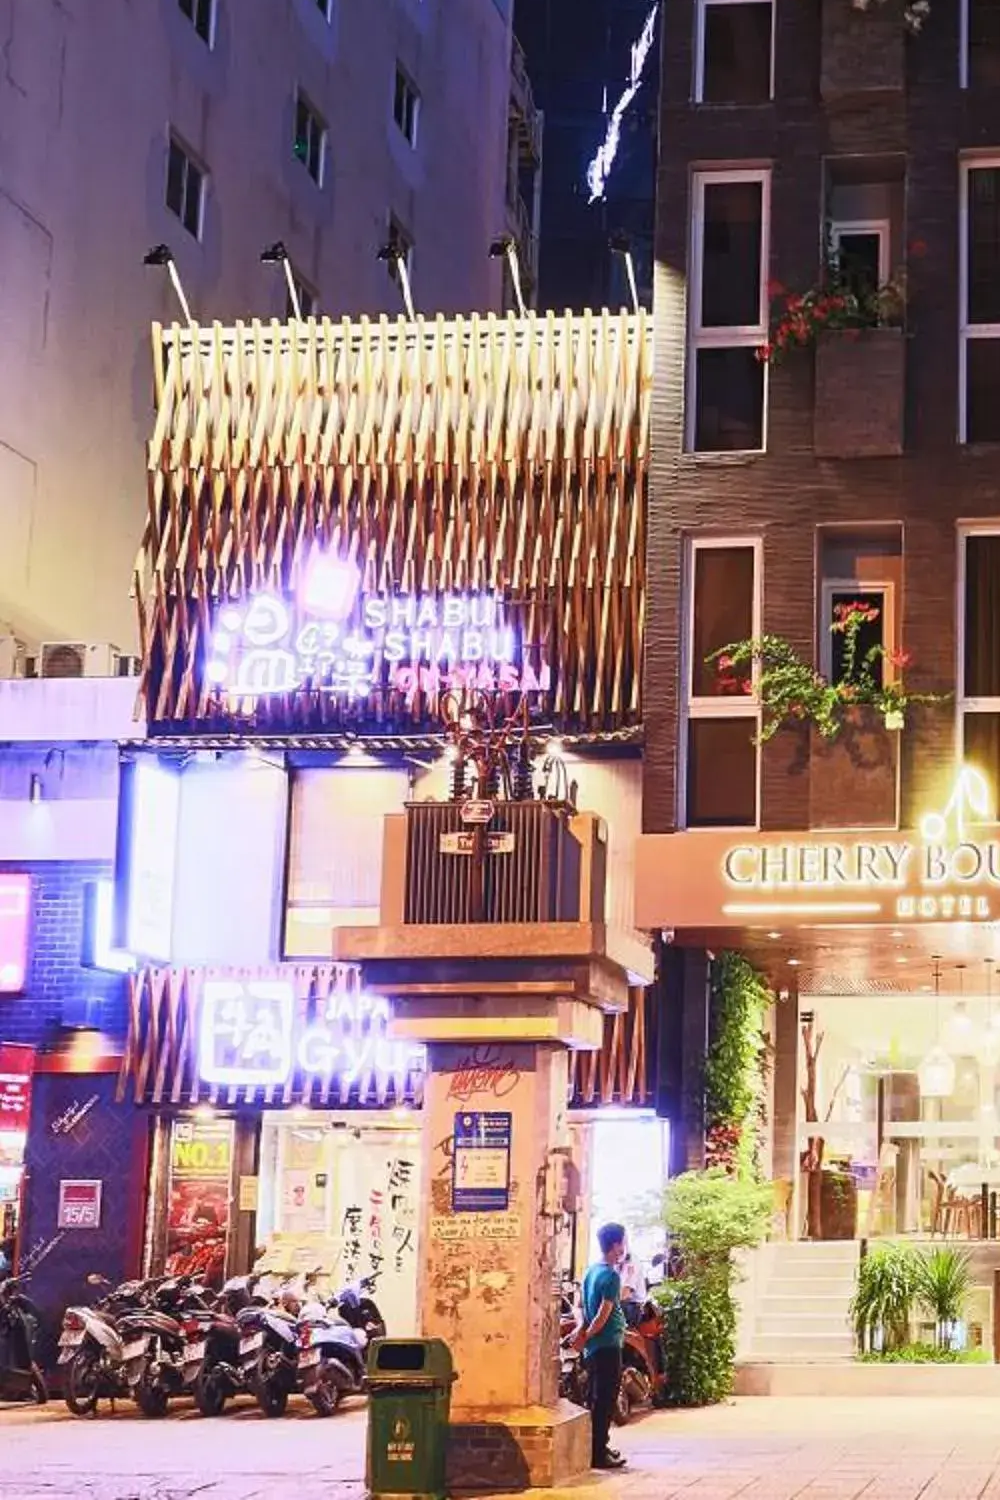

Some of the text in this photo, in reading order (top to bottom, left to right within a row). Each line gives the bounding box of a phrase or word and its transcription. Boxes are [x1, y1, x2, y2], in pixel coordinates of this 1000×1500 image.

[365, 598, 493, 627] SHABU
[383, 630, 515, 661] SHABU
[724, 843, 907, 884] CHERRY
[896, 895, 989, 918] HOTEL
